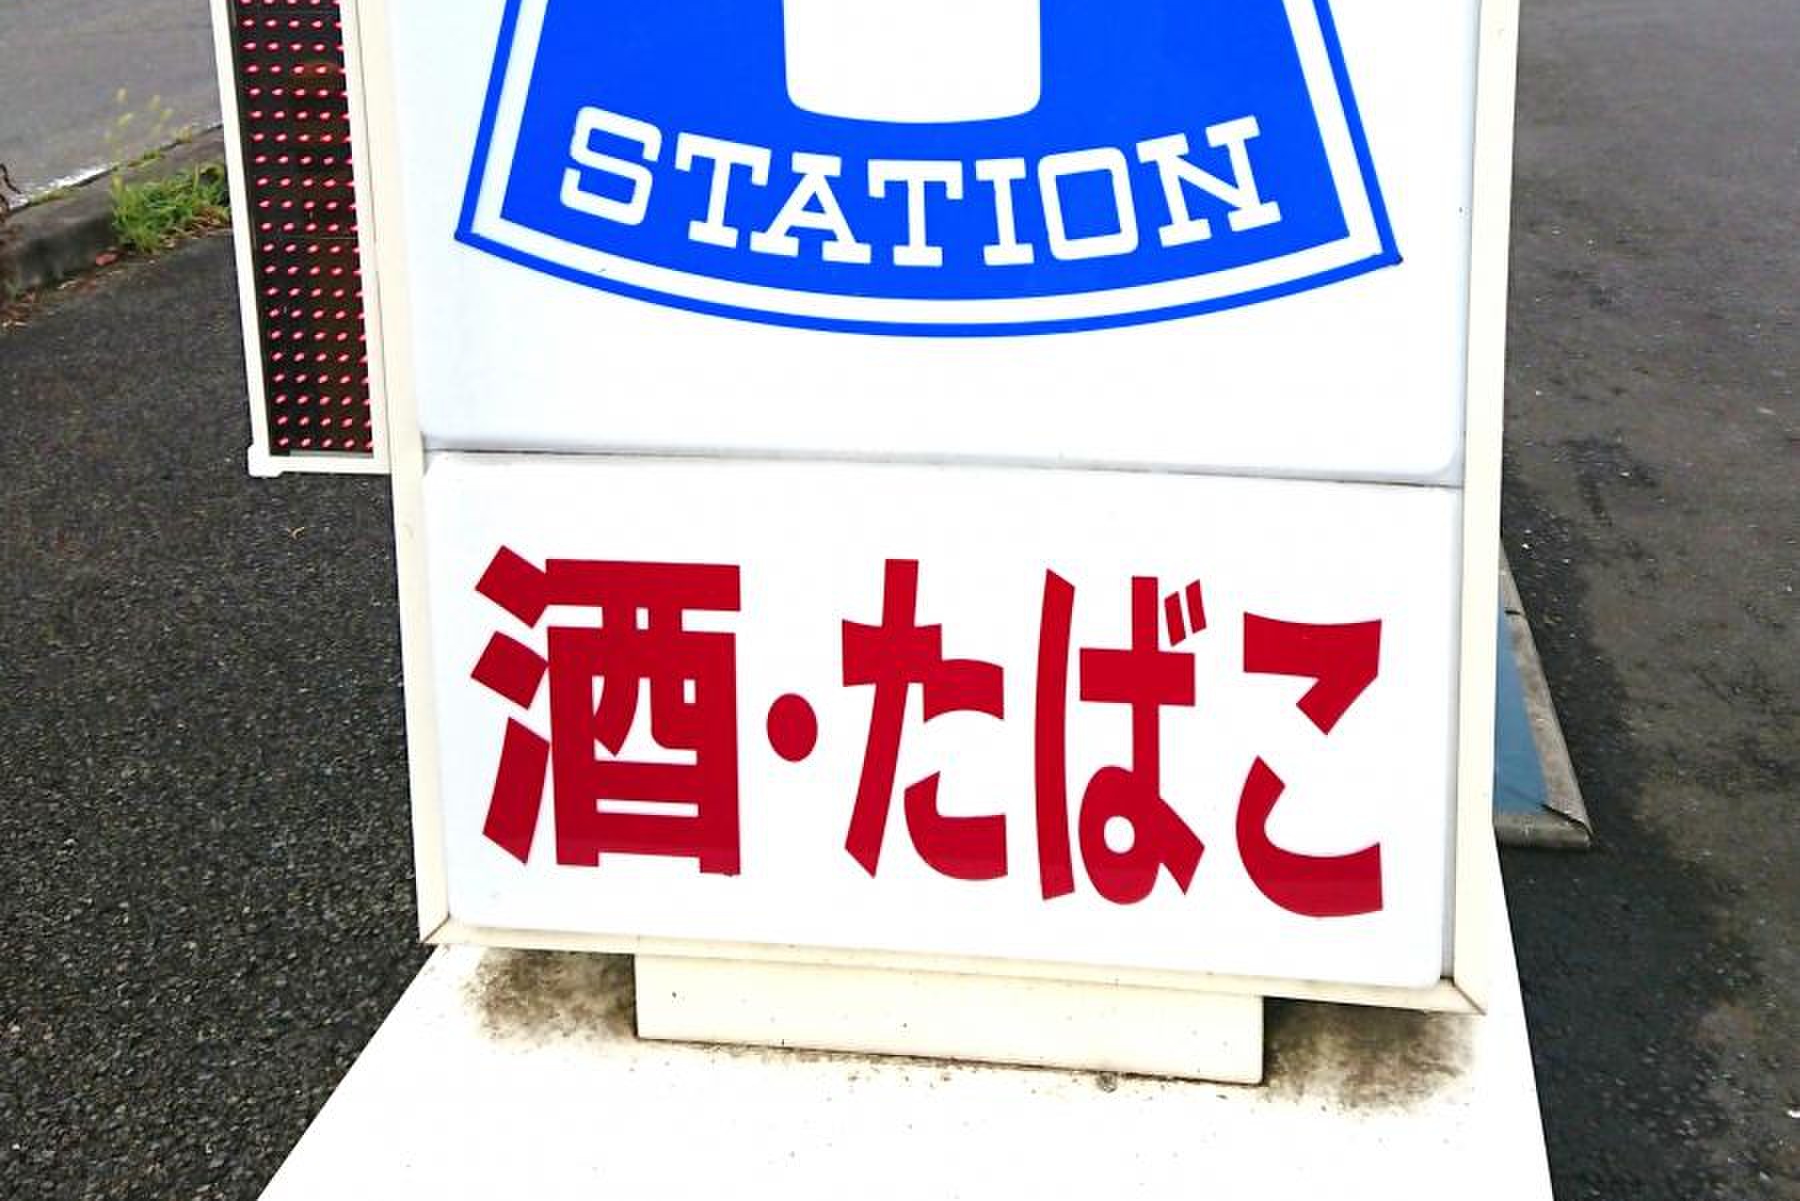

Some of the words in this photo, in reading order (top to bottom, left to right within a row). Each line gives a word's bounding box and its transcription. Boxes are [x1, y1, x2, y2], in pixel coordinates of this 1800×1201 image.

[560, 107, 1281, 267] STATION
[470, 545, 1384, 918] 酒・たばこ
